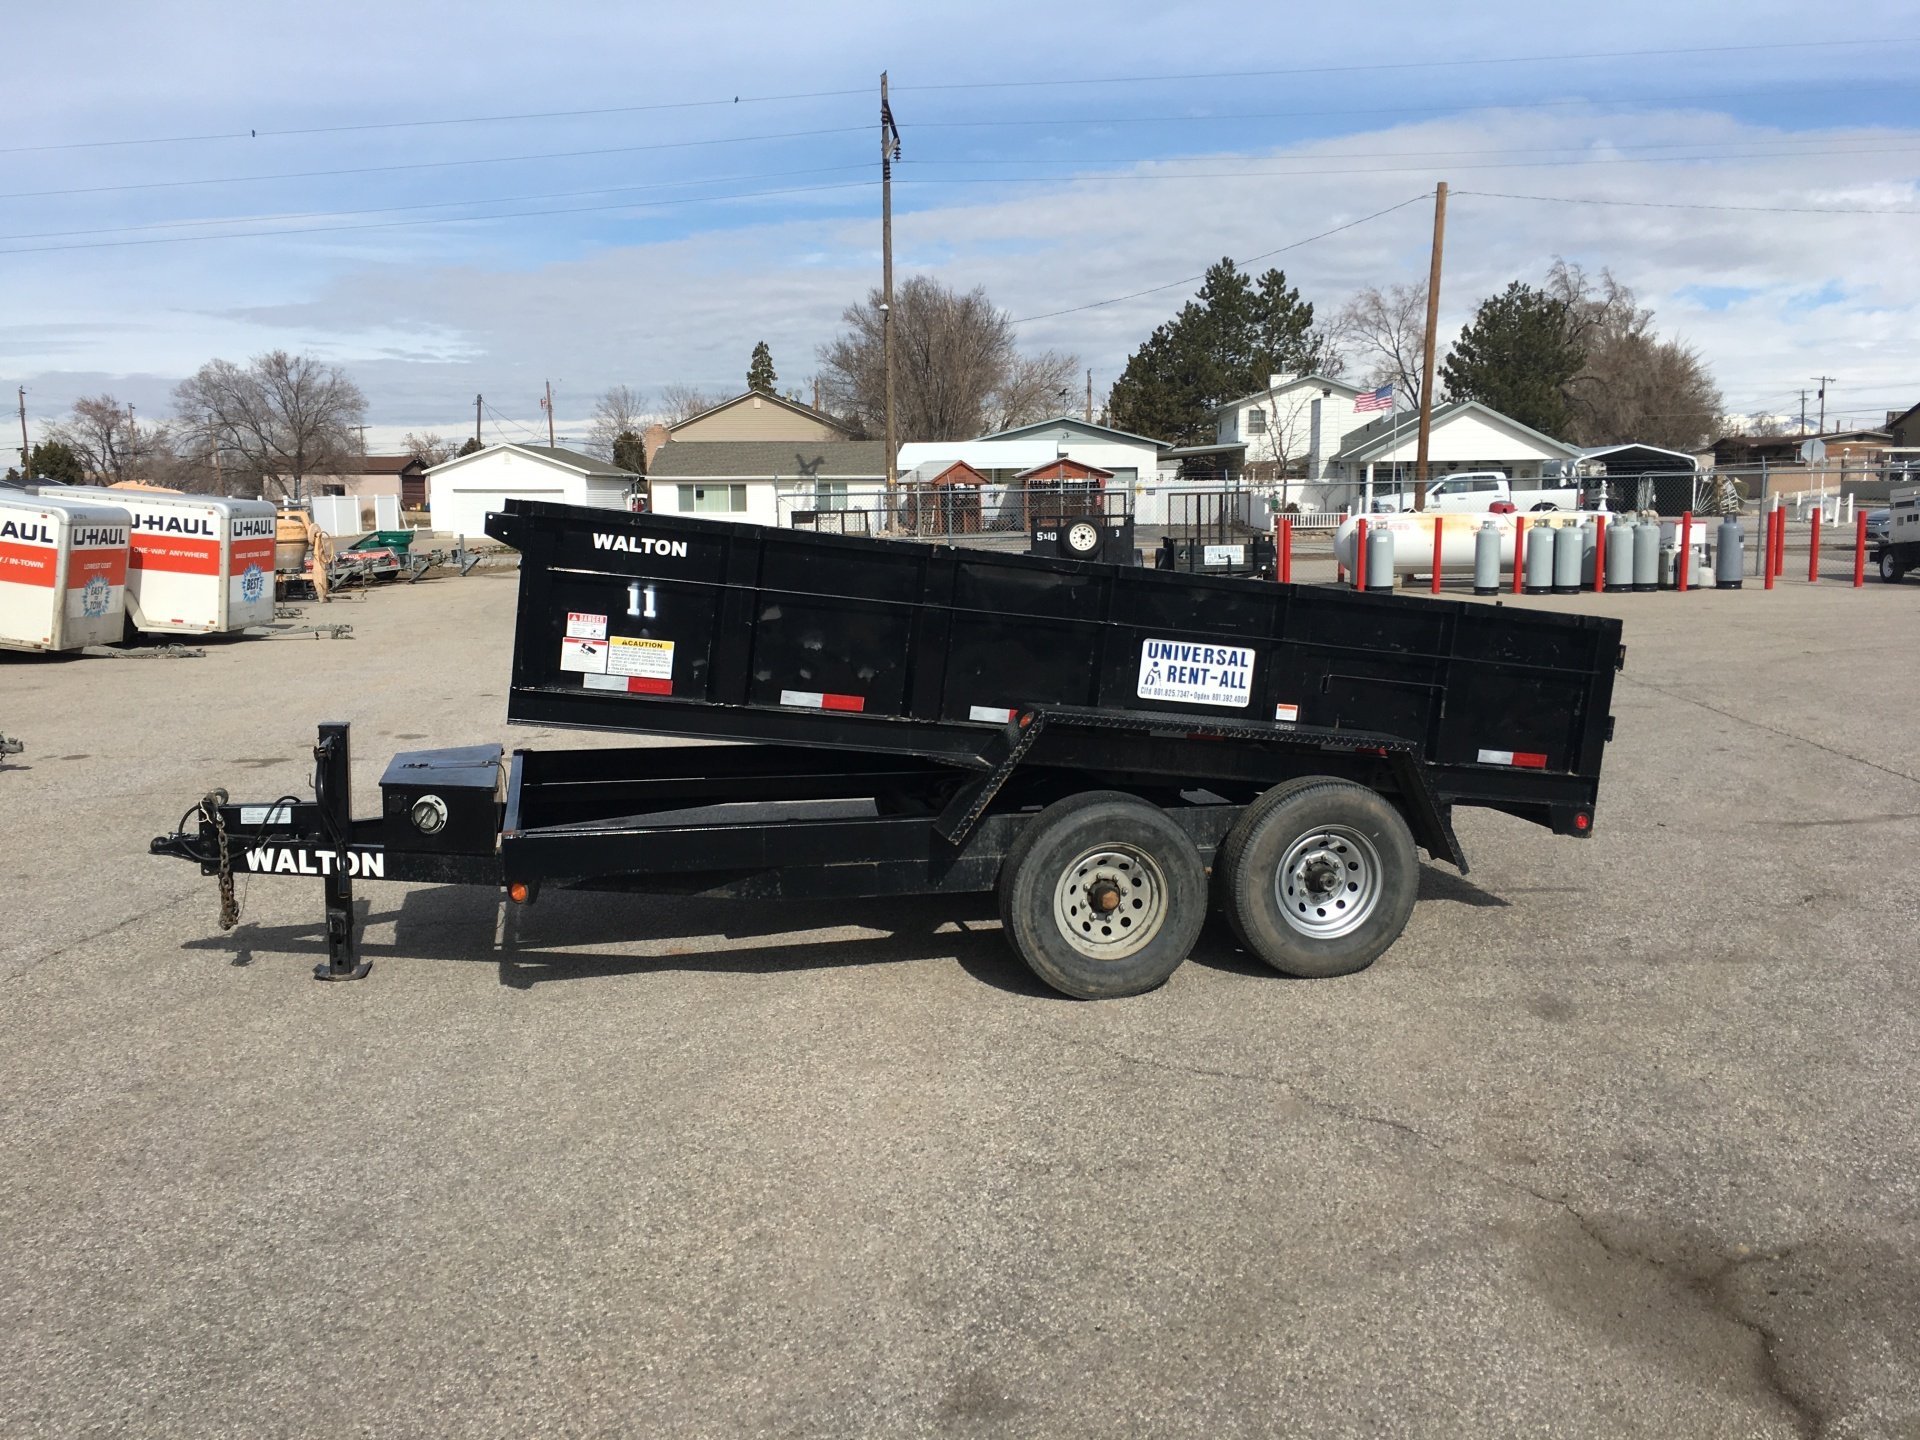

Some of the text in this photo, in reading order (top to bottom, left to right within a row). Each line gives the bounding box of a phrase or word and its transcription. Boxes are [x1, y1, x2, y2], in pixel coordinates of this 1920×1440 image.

[233, 520, 273, 536] U-HAUL
[1115, 529, 1120, 538] 3
[73, 528, 125, 545] U-HAUL
[592, 532, 688, 558] WALTON
[133, 546, 209, 559] ONE-WAY ANYWHERE
[1180, 550, 1186, 560] 4
[9, 557, 44, 569] IN-TOWN
[91, 586, 103, 596] EASY
[247, 577, 260, 591] BEST
[627, 583, 656, 617] 11
[628, 640, 663, 649] CAUTION
[1147, 642, 1249, 668] UNIVERSAL
[1166, 665, 1247, 689] RENT-ALL
[1194, 691, 1210, 701] Ogden
[245, 847, 385, 878] WALTON
